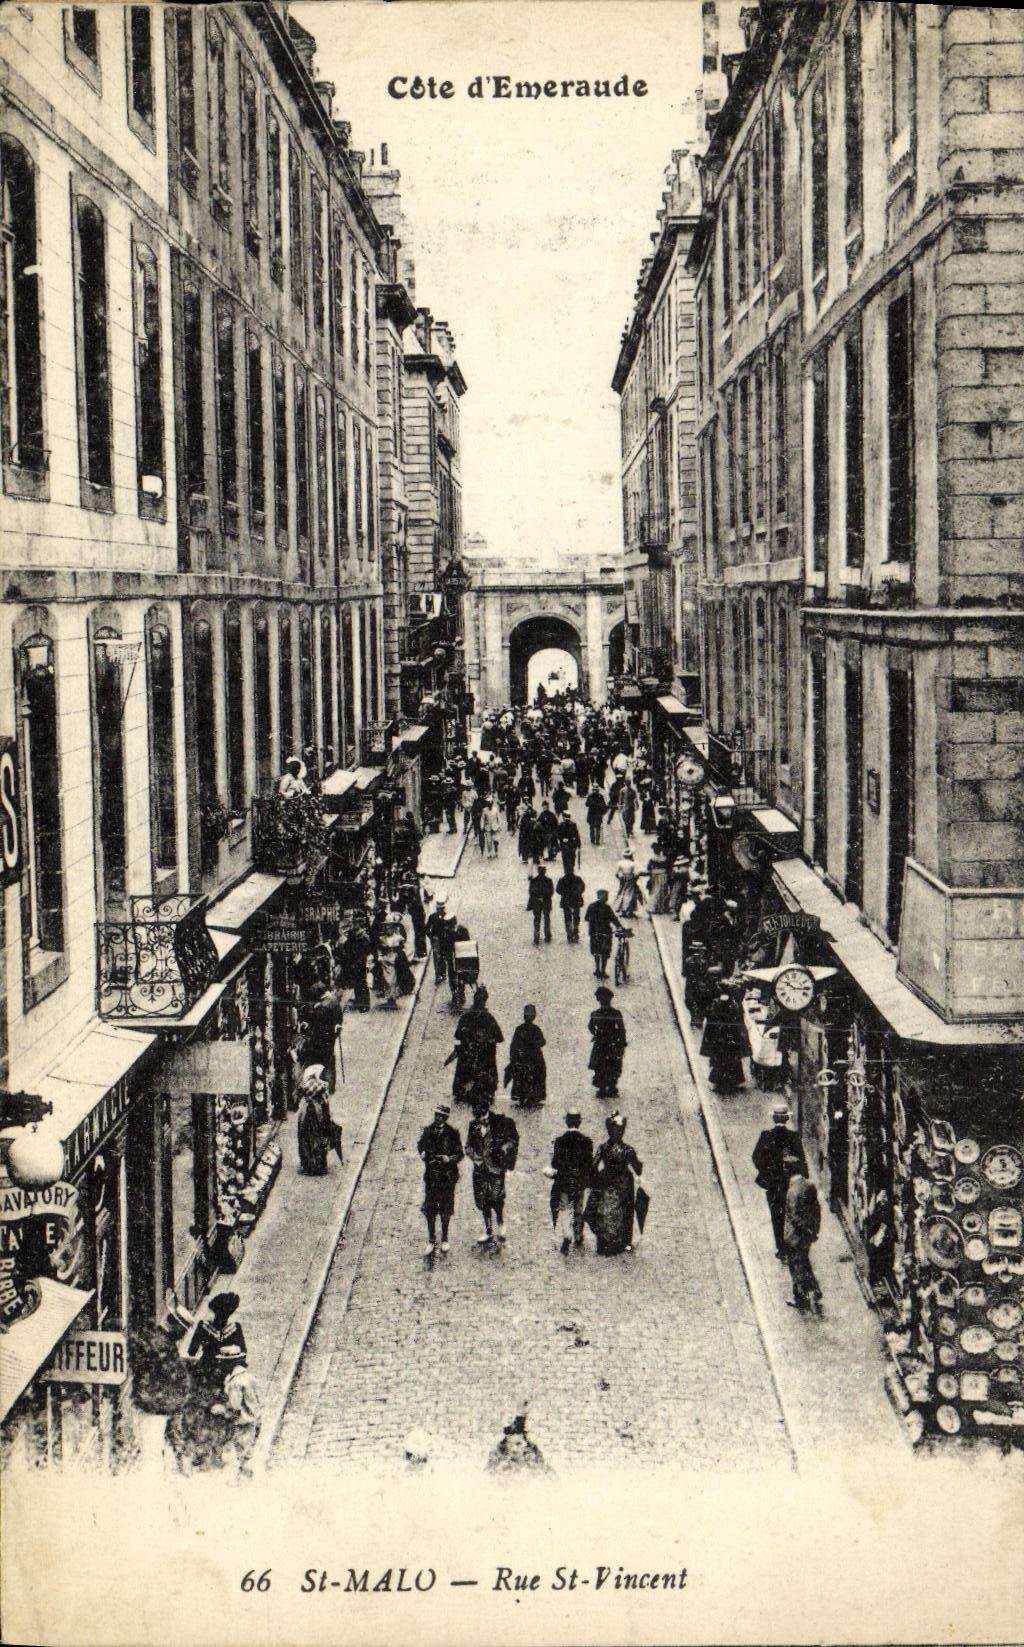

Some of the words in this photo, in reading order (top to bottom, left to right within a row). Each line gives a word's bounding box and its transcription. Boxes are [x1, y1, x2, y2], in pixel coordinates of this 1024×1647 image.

[0, 751, 18, 869] S
[261, 942, 308, 952] APETERIE
[262, 929, 306, 942] IBRAIRIE
[64, 1077, 130, 1178] HARMACIE
[0, 1187, 75, 1212] AVATORY
[57, 1340, 124, 1373] IFFEUR
